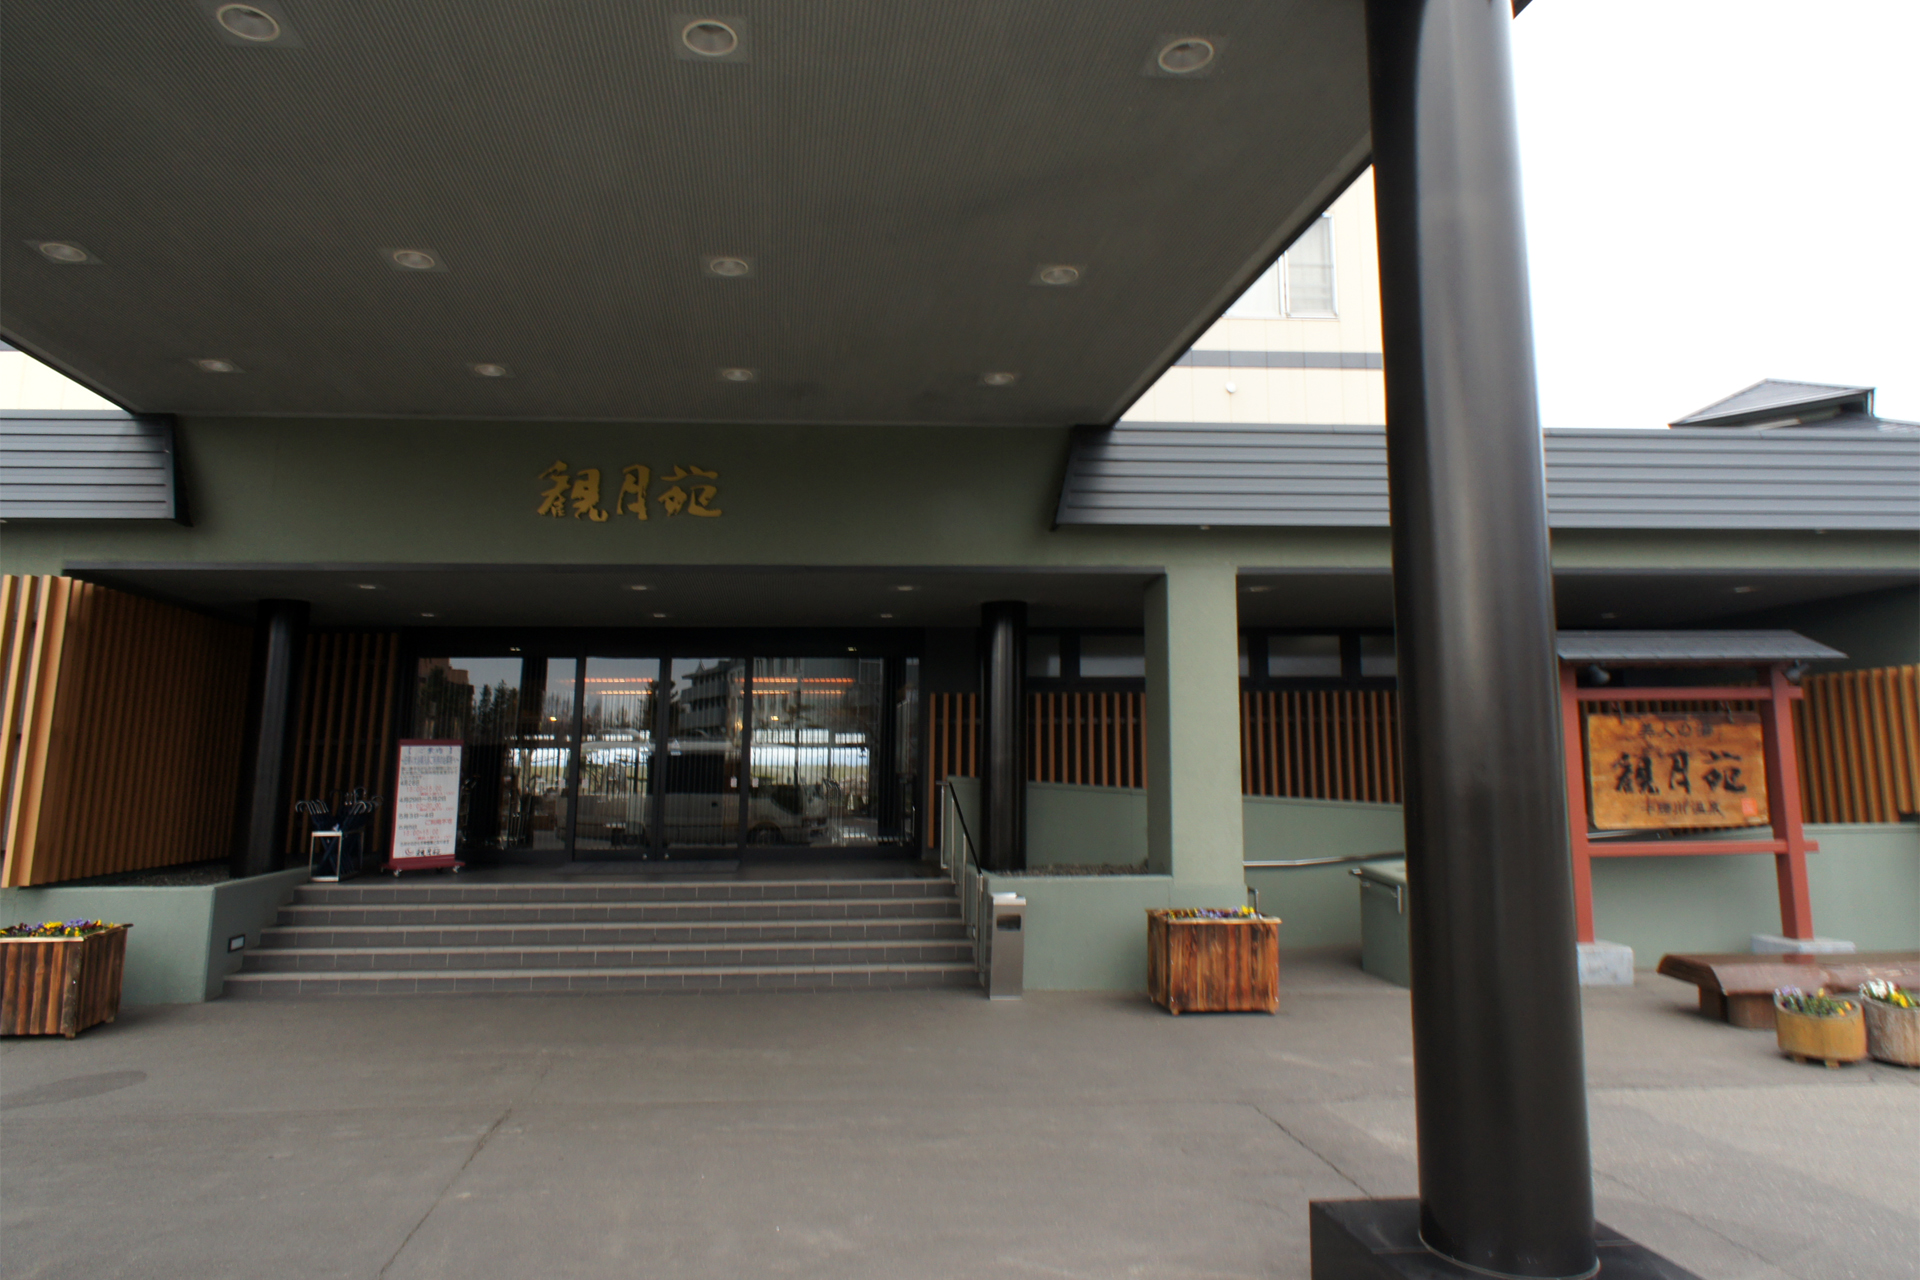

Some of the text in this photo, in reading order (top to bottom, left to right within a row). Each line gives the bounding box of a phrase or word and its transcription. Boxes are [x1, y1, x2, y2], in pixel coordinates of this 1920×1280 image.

[537, 460, 722, 522] 観月苑
[1612, 750, 1747, 795] 観月苑
